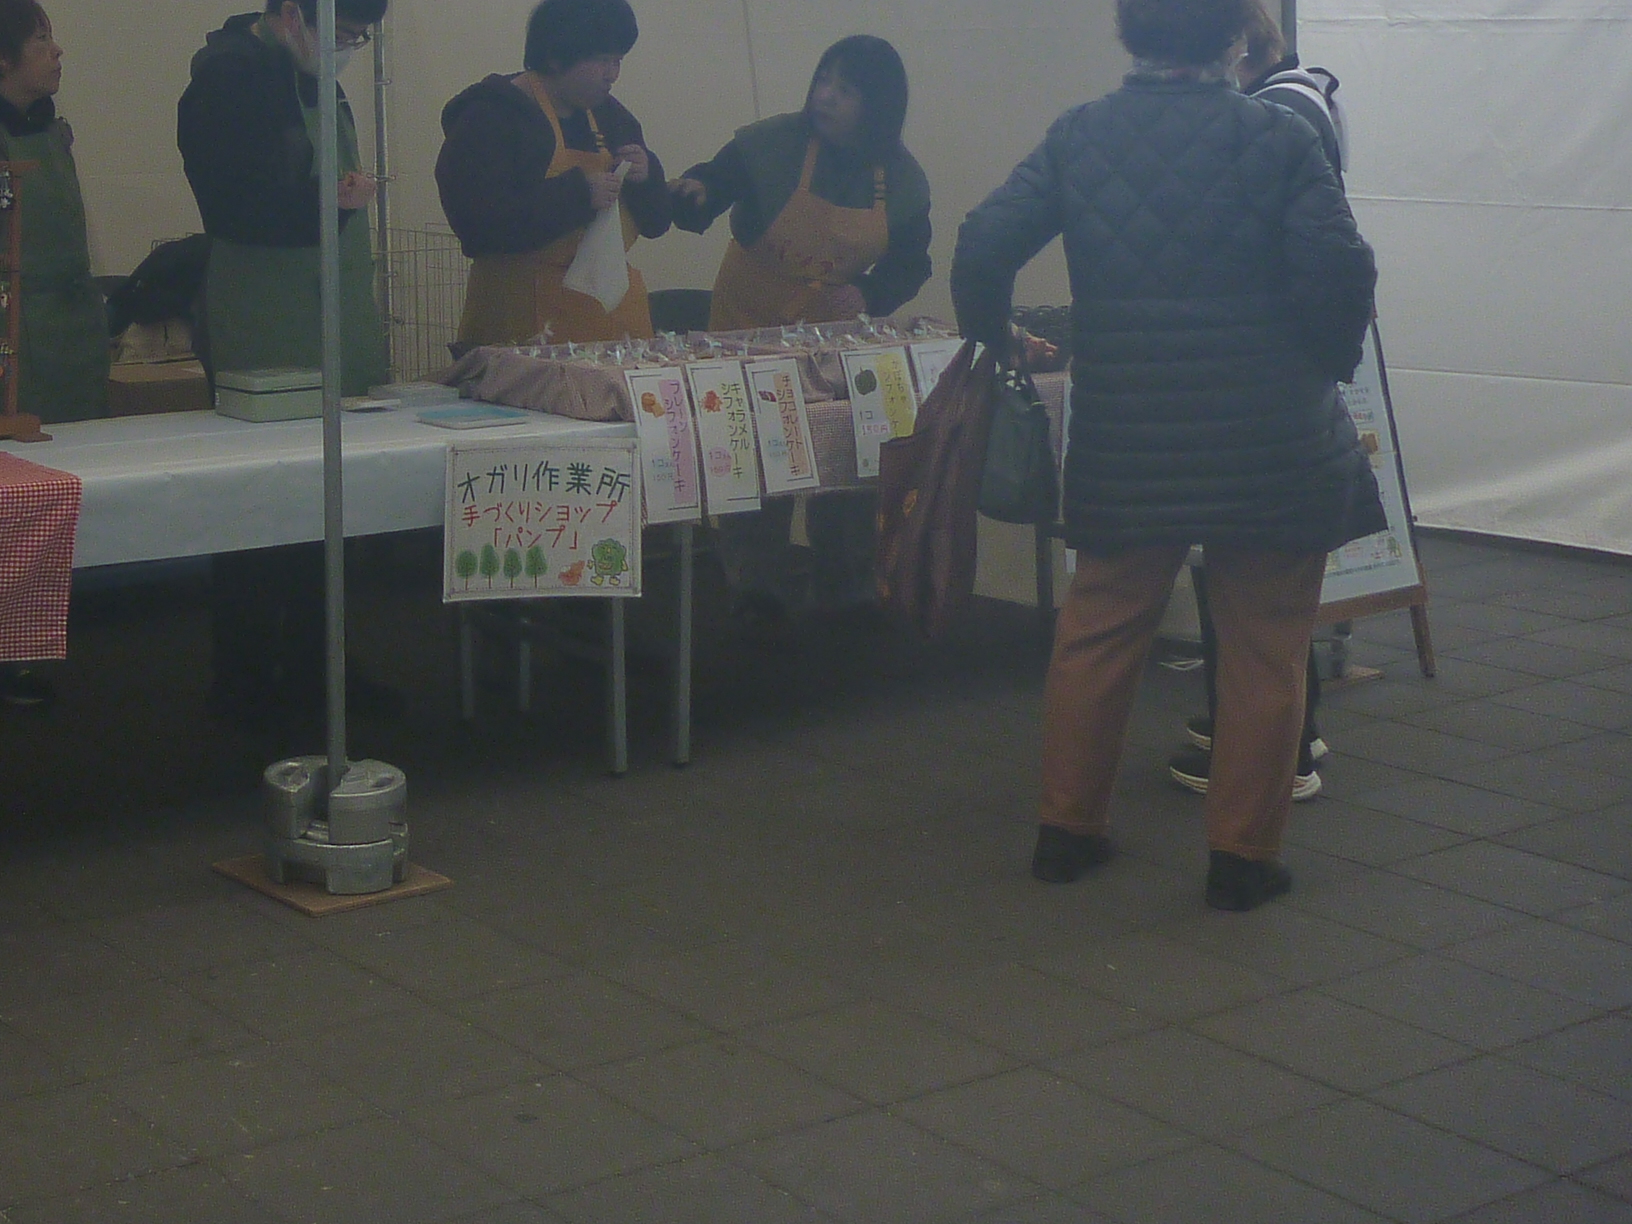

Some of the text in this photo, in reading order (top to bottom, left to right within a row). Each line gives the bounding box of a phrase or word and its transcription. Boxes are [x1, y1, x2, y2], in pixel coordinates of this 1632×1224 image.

[721, 383, 743, 479] シフォンケーキ
[731, 383, 750, 450] キャラメル
[457, 460, 631, 503] オガリ作業所
[462, 500, 617, 527] 手づくりショップ
